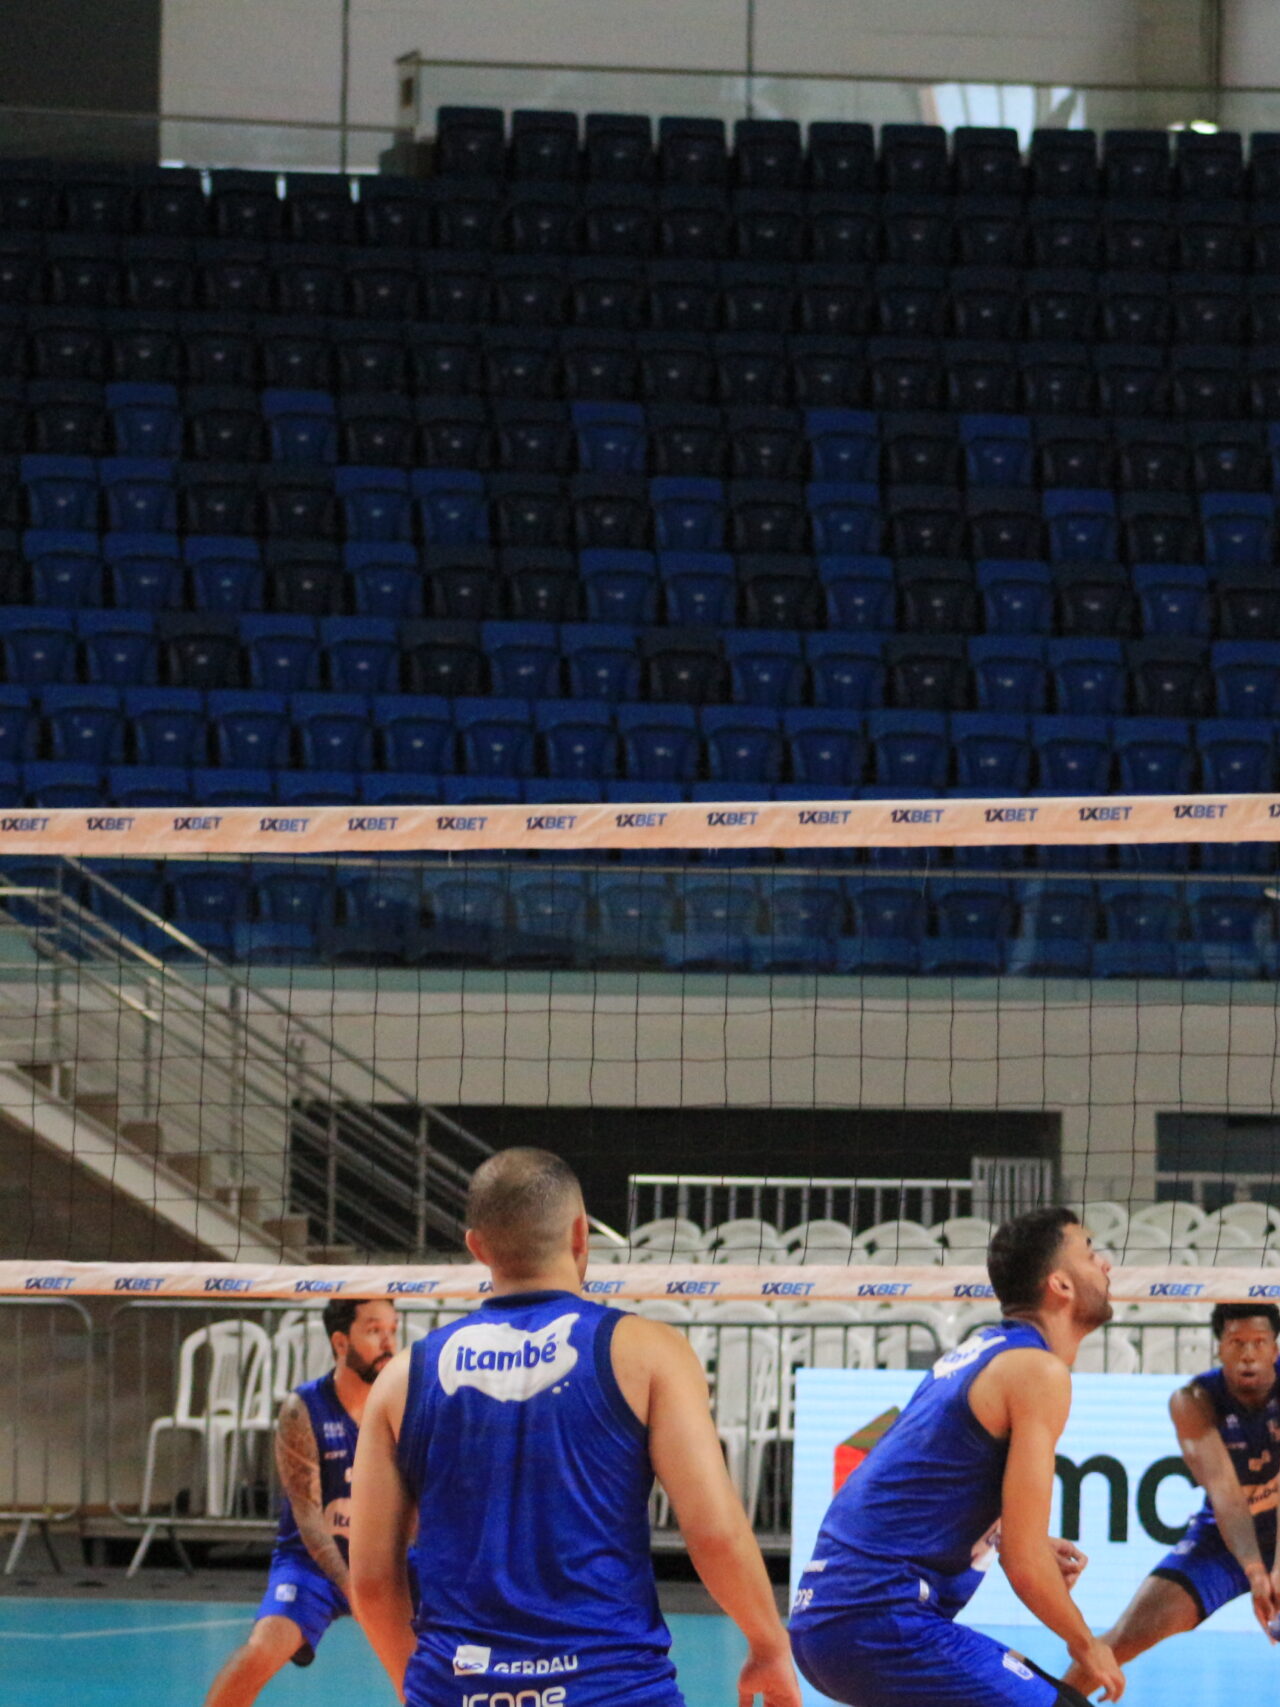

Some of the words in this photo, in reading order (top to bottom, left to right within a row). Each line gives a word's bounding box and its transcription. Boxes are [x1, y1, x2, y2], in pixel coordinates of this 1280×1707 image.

[0, 817, 50, 831] 1XBET
[85, 816, 135, 830] 1XBET
[173, 815, 223, 831] 1XBET
[259, 817, 310, 832] 1XBET
[347, 816, 399, 831] 1XBET
[436, 816, 488, 830] 1XBET
[526, 815, 577, 830] 1XBET
[615, 812, 668, 827] 1XBET
[706, 811, 759, 826] 1XBET
[797, 809, 852, 824] 1XBET
[890, 808, 945, 823] 1XBET
[984, 807, 1039, 822] 1XBET
[1078, 806, 1133, 821] 1XBET
[1173, 804, 1228, 818] 1XBET
[25, 1277, 76, 1291] 1XBET
[113, 1278, 165, 1291] 1XBET
[203, 1278, 254, 1292] 1XBET
[294, 1279, 346, 1293] 1XBET
[386, 1280, 439, 1293] 1XBET
[665, 1281, 721, 1295] 1XBET
[760, 1281, 815, 1296] 1XBET
[857, 1283, 912, 1296] 1XBET
[954, 1284, 995, 1297] 1XBE
[1149, 1283, 1204, 1297] 1XBET
[456, 1333, 557, 1372] itambé
